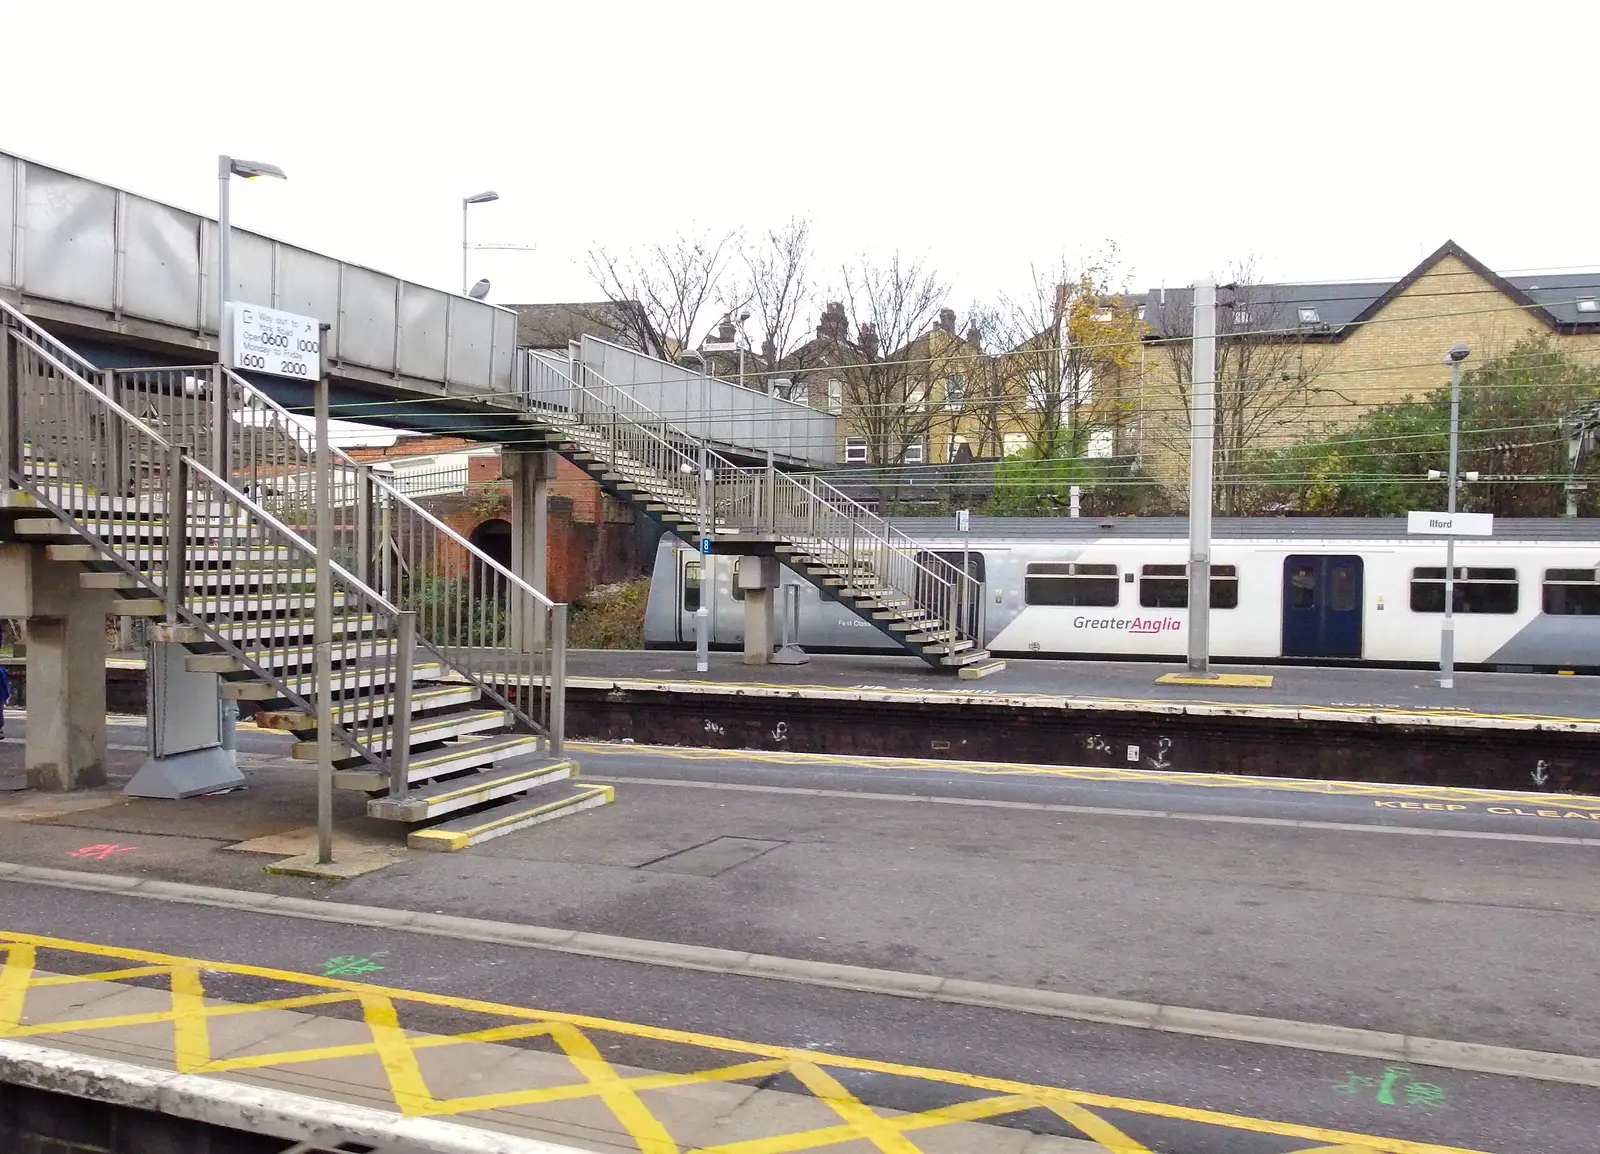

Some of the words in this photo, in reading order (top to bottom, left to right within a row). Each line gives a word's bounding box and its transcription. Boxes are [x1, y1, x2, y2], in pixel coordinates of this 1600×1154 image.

[258, 311, 273, 324] Way
[276, 317, 288, 325] out
[291, 320, 299, 328] to
[276, 326, 293, 337] Road
[243, 331, 262, 341] Open
[261, 332, 288, 348] 0600
[297, 337, 320, 354] 1000
[243, 342, 270, 356] Monday
[273, 348, 281, 356] to
[283, 349, 302, 361] Friday
[240, 352, 265, 369] 1600
[281, 360, 307, 376] 2000
[1429, 519, 1453, 529] Ilford
[1374, 800, 1467, 811] KEEP
